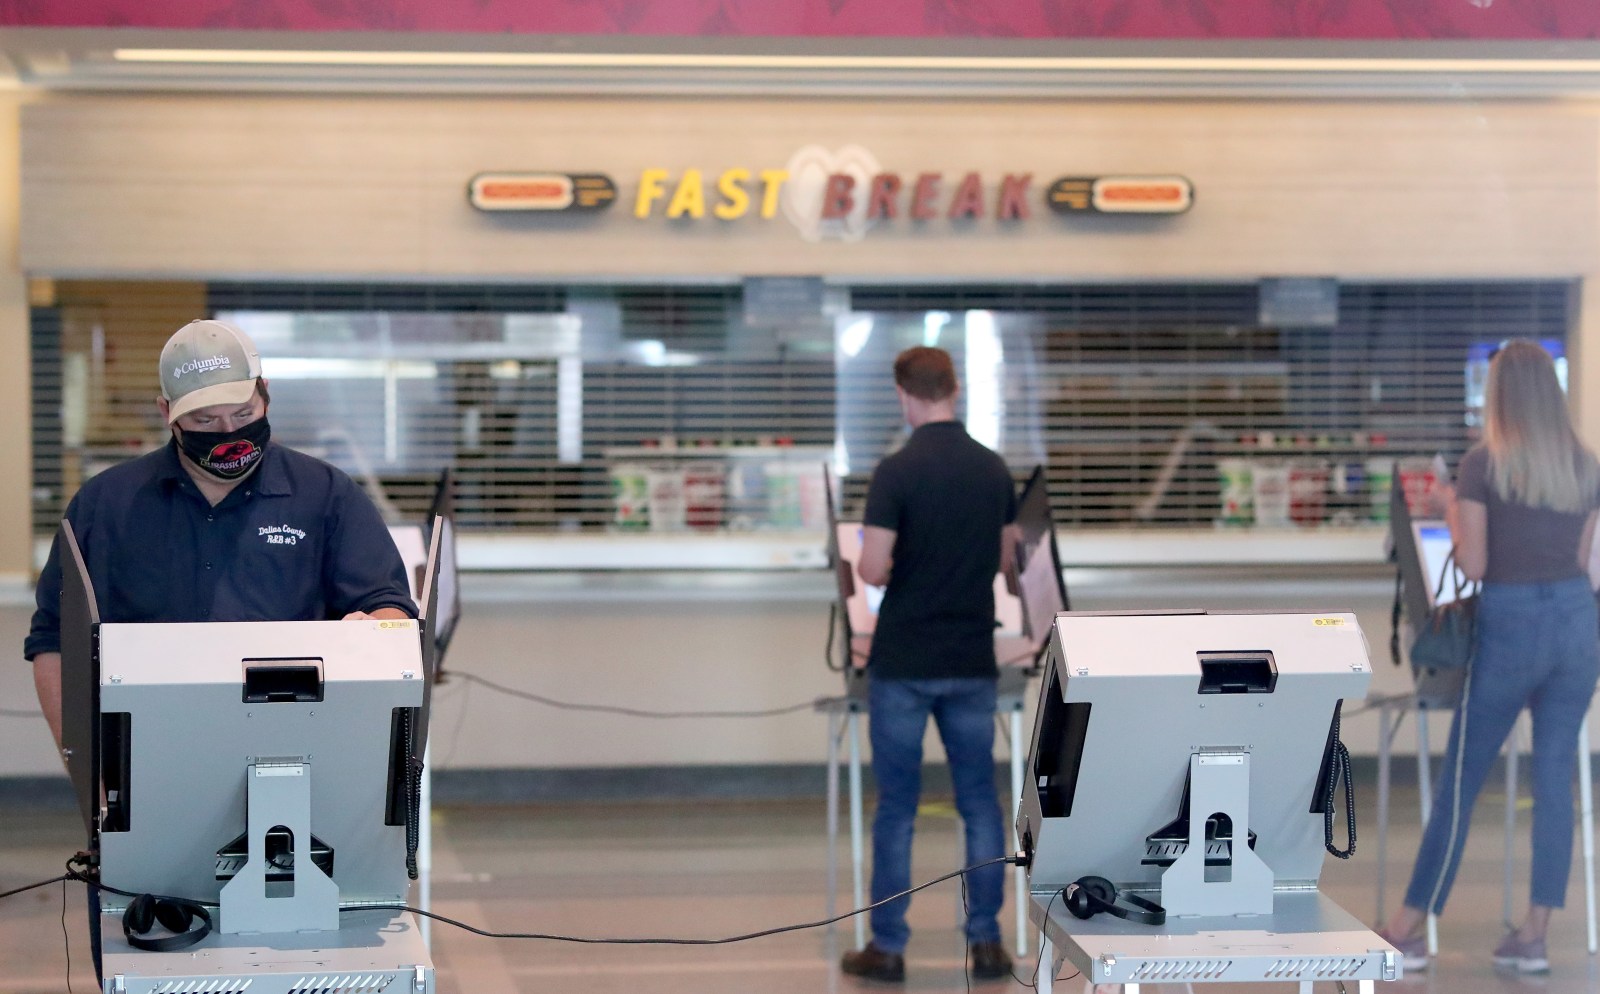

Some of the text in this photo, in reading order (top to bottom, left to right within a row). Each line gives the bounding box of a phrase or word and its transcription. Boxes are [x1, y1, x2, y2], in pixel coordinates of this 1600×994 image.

[634, 168, 1034, 220] FAST BREAK
[181, 354, 230, 374] Columbia
[258, 524, 306, 540] Dallas County
[266, 534, 297, 546] R&B #3
